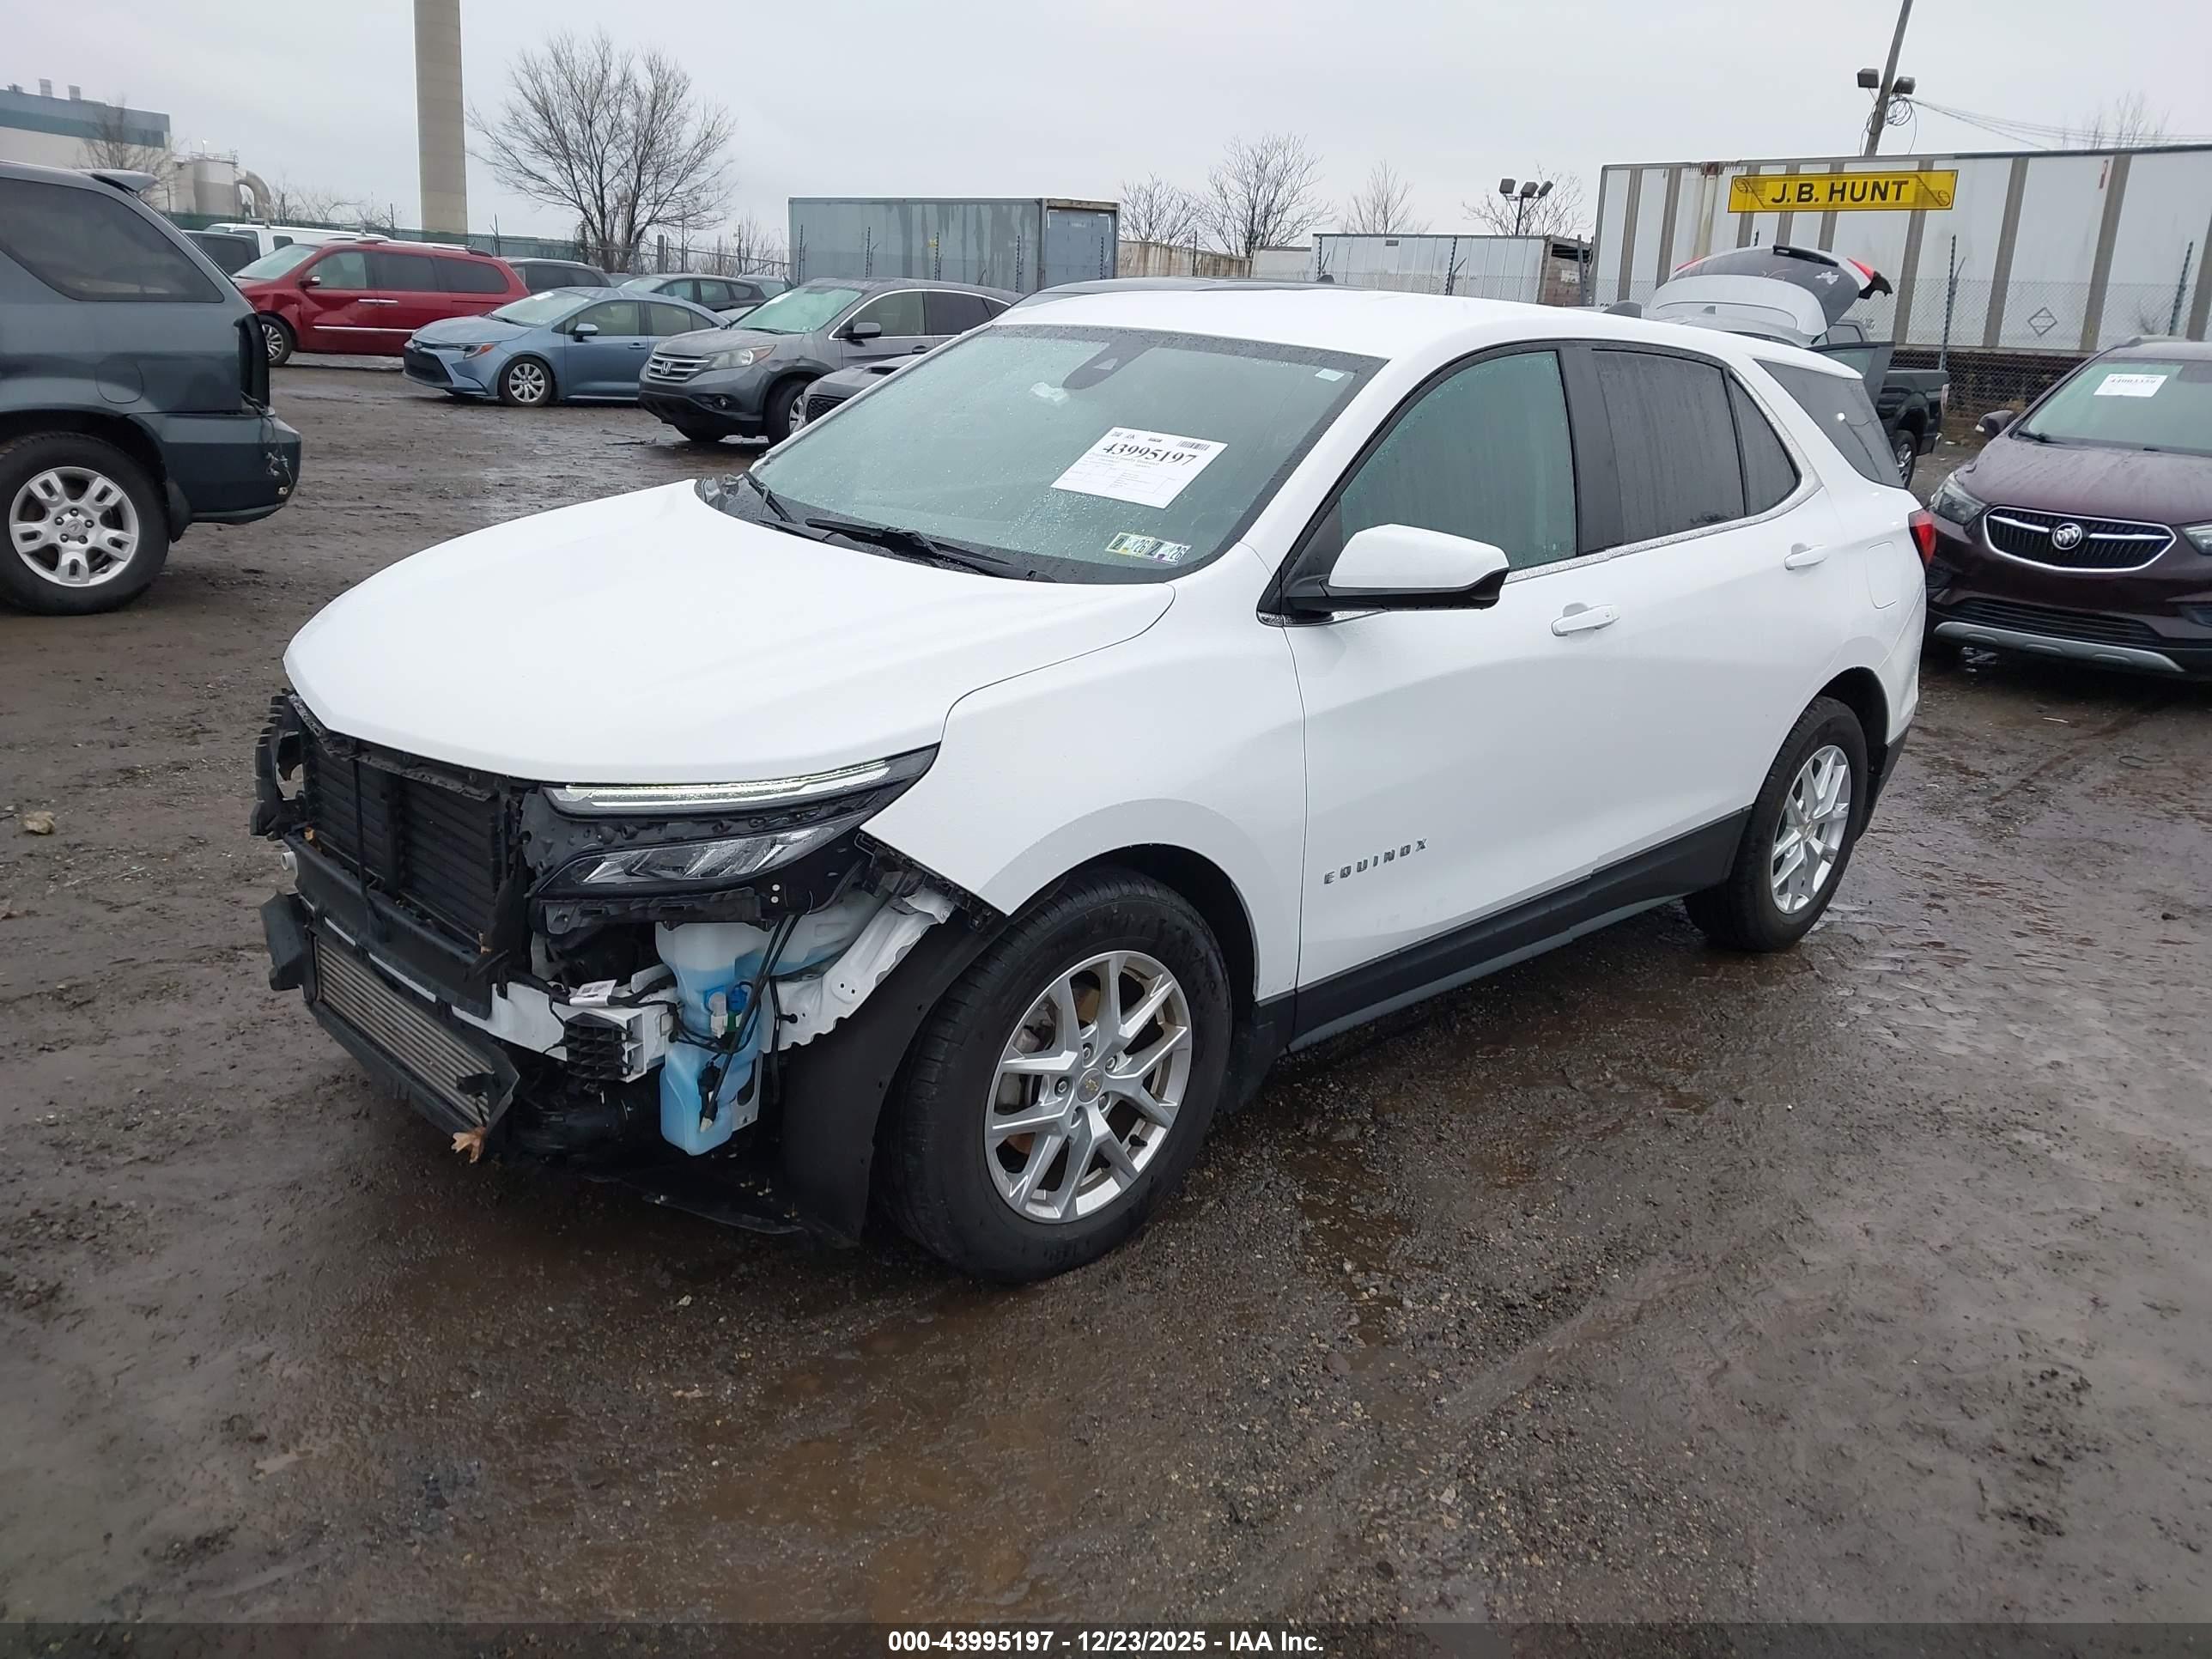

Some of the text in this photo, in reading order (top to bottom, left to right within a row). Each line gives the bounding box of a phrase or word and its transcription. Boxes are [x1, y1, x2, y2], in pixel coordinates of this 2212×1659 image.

[1771, 179, 1909, 203] J.B. HUNT
[1103, 442, 1197, 465] 43995197
[1323, 838, 1427, 884] EQUINOX
